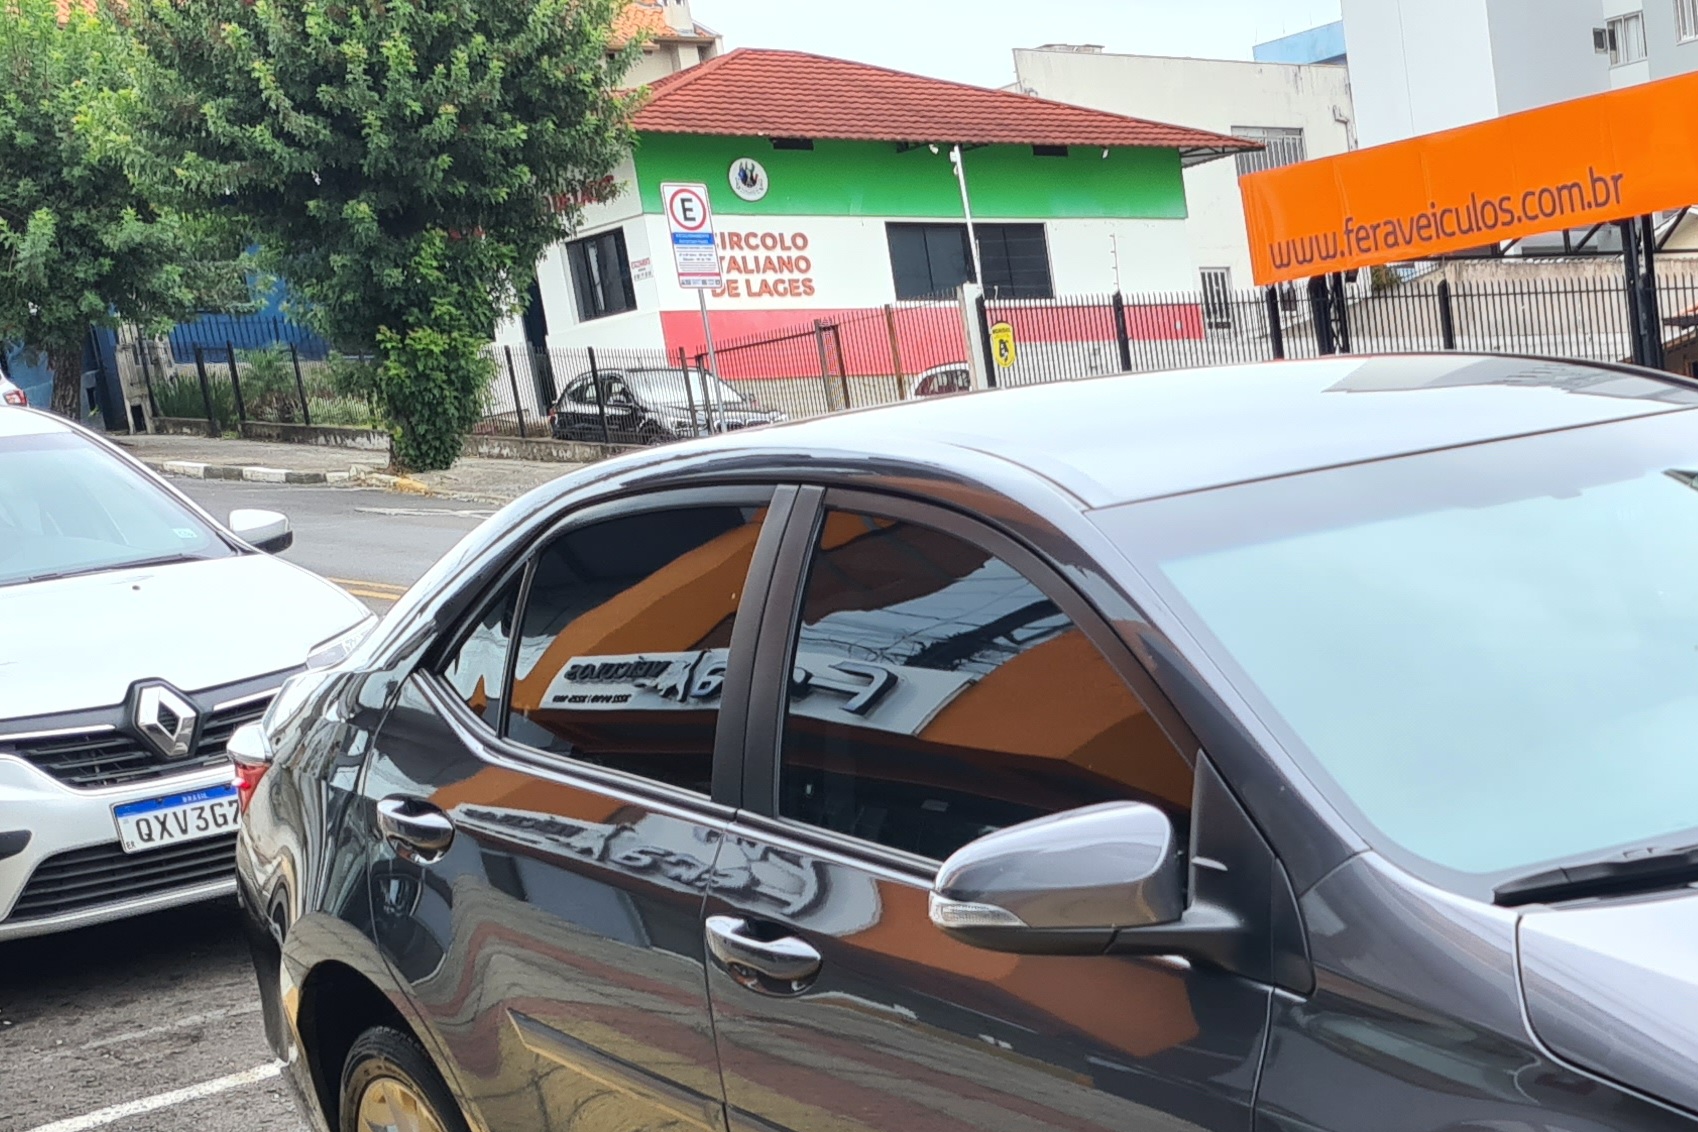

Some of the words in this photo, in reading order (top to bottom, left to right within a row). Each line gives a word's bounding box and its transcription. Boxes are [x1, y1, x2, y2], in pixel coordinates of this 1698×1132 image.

[680, 198, 696, 221] E
[1268, 166, 1624, 270] www.feraveiculos.com.br
[715, 231, 808, 251] IRCOLO
[719, 255, 811, 274] TALIANO
[745, 277, 815, 297] LAGES
[136, 799, 240, 843] QXV3G7
